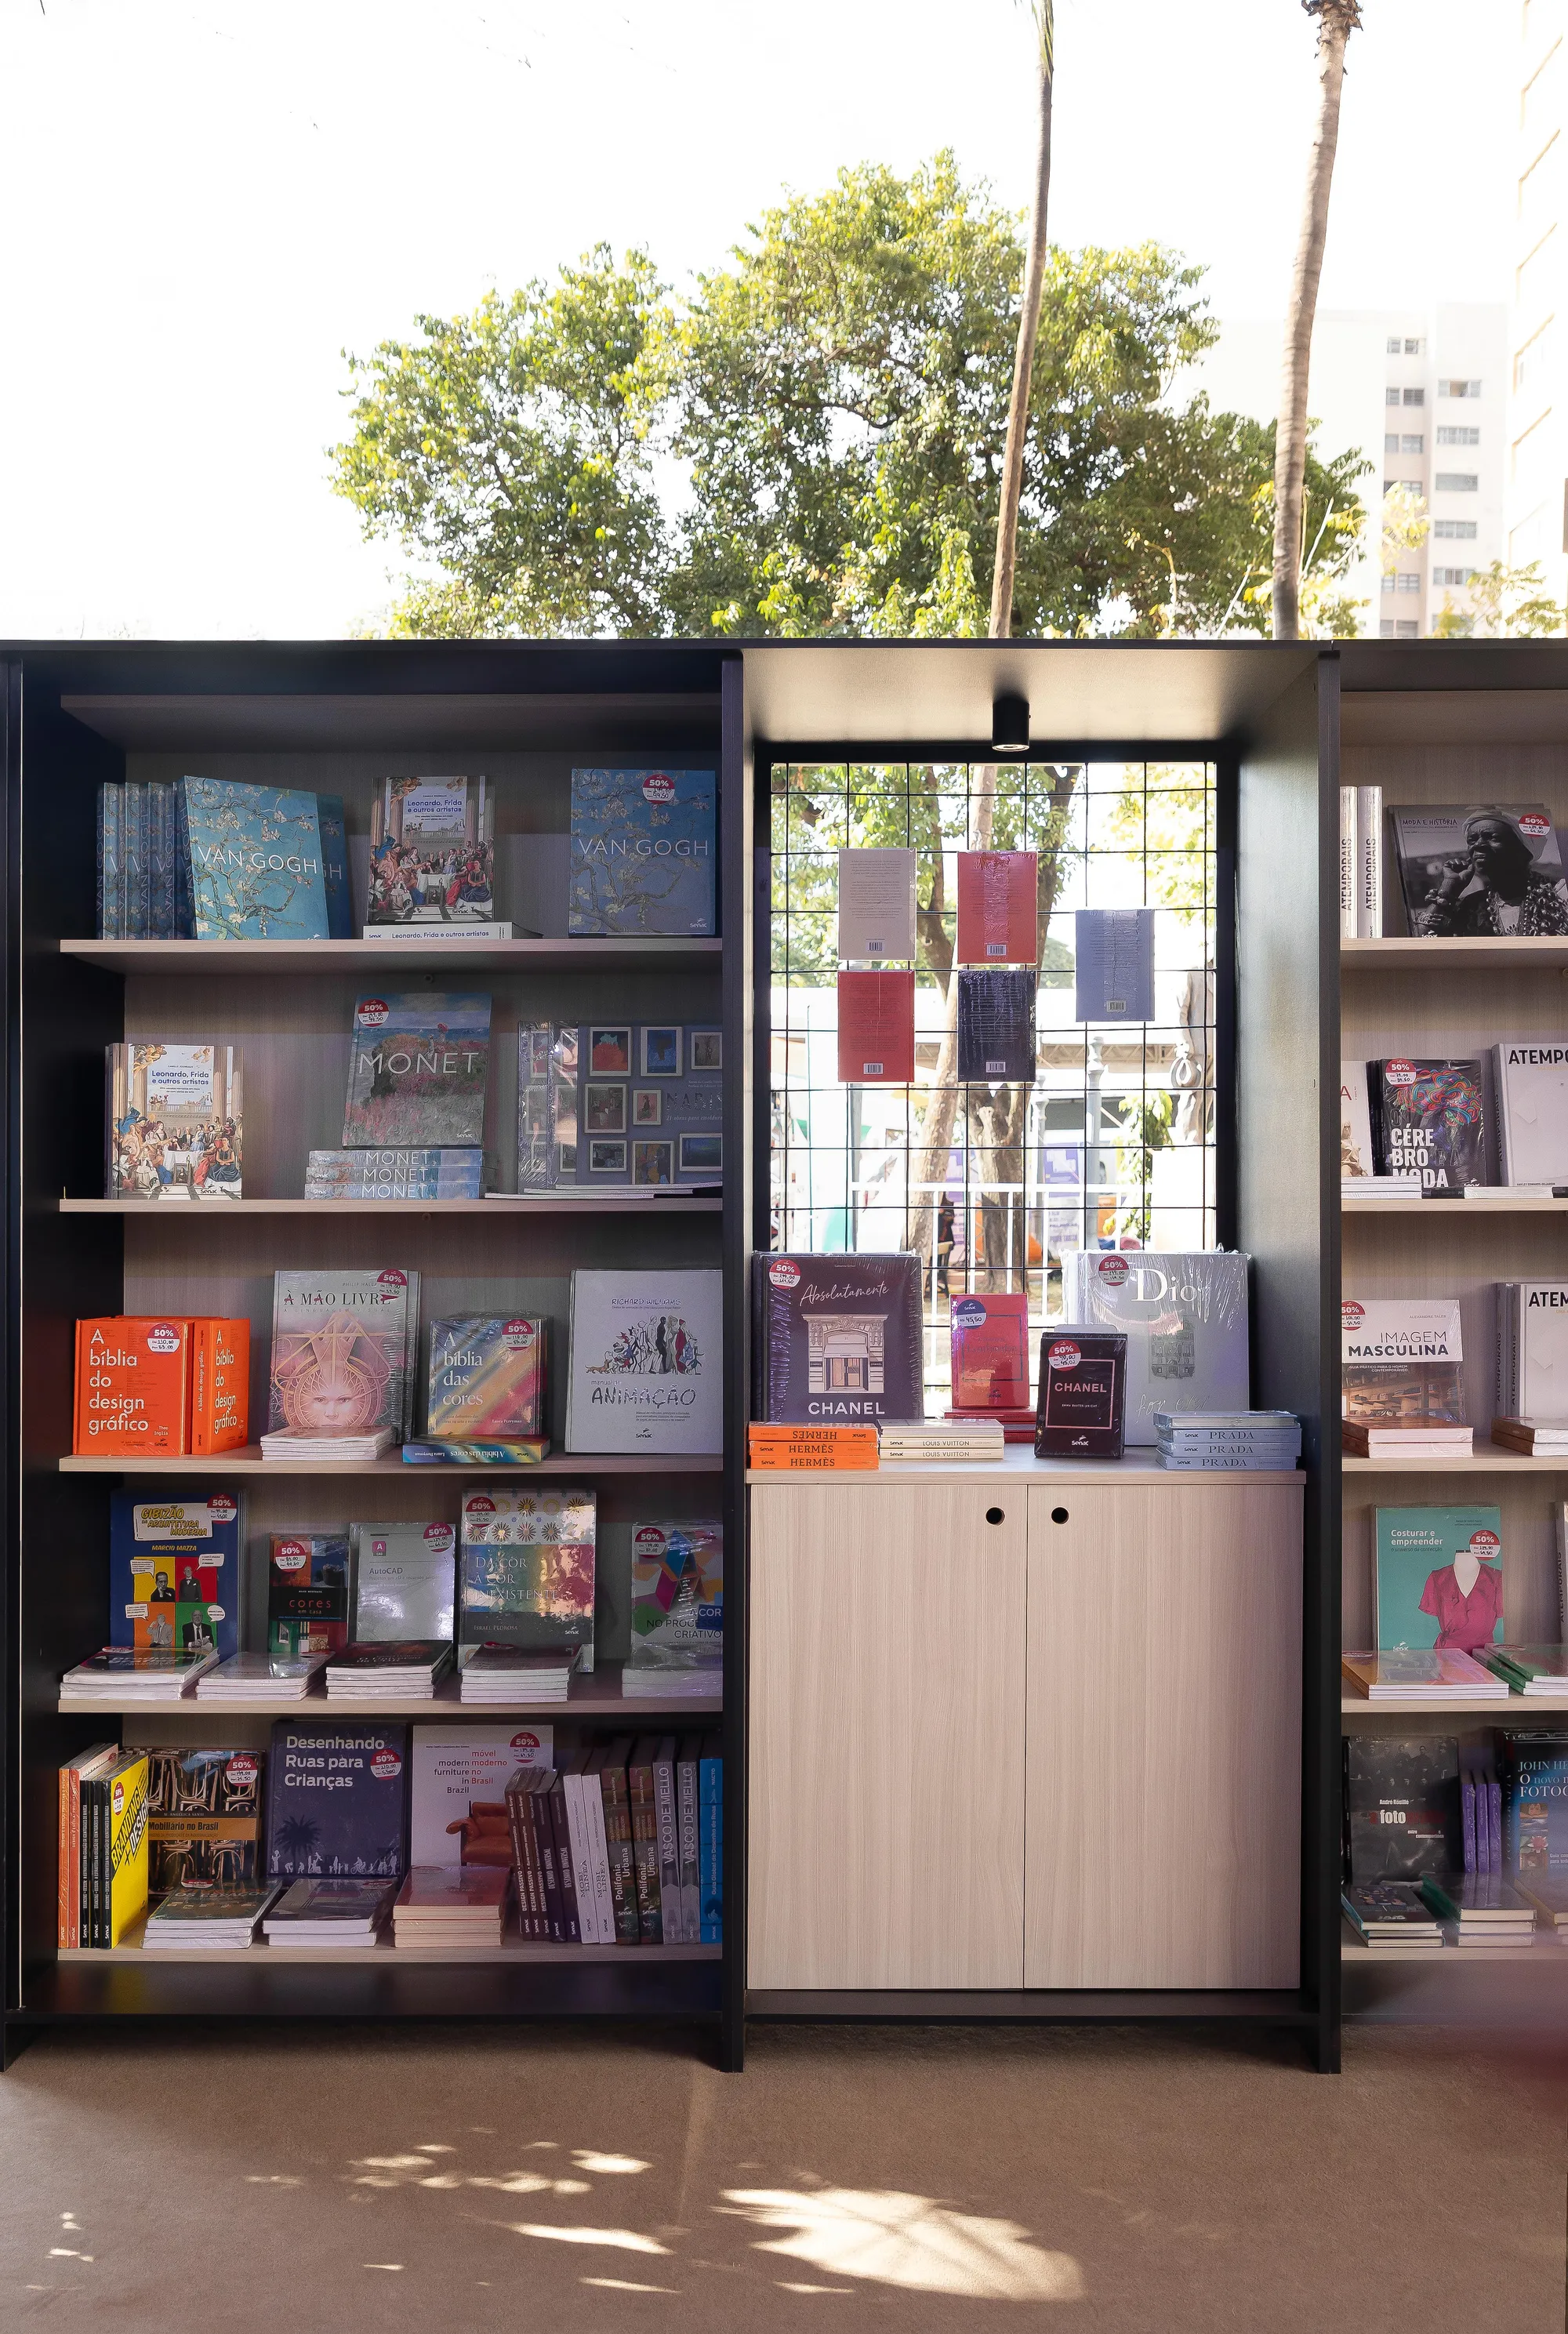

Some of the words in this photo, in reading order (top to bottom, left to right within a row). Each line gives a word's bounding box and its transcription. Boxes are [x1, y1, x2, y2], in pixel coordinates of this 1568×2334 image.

[579, 839, 626, 855] VAN
[636, 840, 708, 855] GOGH
[198, 847, 243, 867] VAN
[251, 852, 318, 874] GOGH
[358, 1052, 479, 1074] MONET
[1391, 1123, 1434, 1146] CÉRE
[365, 1152, 430, 1165] MONET
[1392, 1149, 1428, 1167] BRO
[363, 1168, 428, 1182] MONET
[361, 1185, 427, 1199] MONET
[284, 1290, 295, 1305] À
[300, 1290, 336, 1305] MÃO
[800, 1280, 890, 1306] Absolutamente
[90, 1328, 105, 1345] A
[216, 1330, 223, 1345] A
[444, 1332, 456, 1346] A
[1381, 1331, 1447, 1343] IMAGEM
[89, 1348, 138, 1367] bíblia
[216, 1348, 234, 1366] bíblia
[1348, 1344, 1449, 1356] MASCULINA
[444, 1350, 483, 1366] bíblia
[89, 1370, 112, 1387] do
[215, 1370, 225, 1387] do
[443, 1370, 470, 1386] das
[1054, 1382, 1107, 1392] CHANEL
[89, 1391, 144, 1414] design
[215, 1391, 236, 1410] design
[442, 1393, 484, 1406] cores
[591, 1384, 696, 1409] ANIMAÇÃO
[808, 1402, 885, 1415] CHANEL
[88, 1413, 149, 1436] gráfico
[214, 1410, 238, 1435] gráfico
[793, 1431, 837, 1440] HERMÈS
[789, 1443, 833, 1453] HERMÈS
[790, 1457, 835, 1466] HERMÈS
[141, 1505, 184, 1519] GIBIZÃO
[147, 1519, 200, 1528] ARQUITETURA
[1391, 1537, 1443, 1546] empreender
[499, 1557, 528, 1568] COR
[474, 1572, 482, 1584] À
[474, 1589, 559, 1599] INEXISTENTE
[289, 1599, 332, 1608] cores
[287, 1736, 385, 1749] Desenhando
[285, 1755, 325, 1767] Ruas
[328, 1756, 364, 1770] para
[1518, 1761, 1550, 1772] JOHN
[285, 1773, 354, 1790] Crianças
[659, 1767, 670, 1805] MELLO
[683, 1767, 693, 1805] MELLO
[1519, 1773, 1530, 1784] O
[662, 1808, 671, 1823] DE
[684, 1808, 693, 1823] DE
[111, 1789, 141, 1868] BRANDING
[129, 1793, 148, 1853] DESIGN
[662, 1827, 673, 1864] VASCO
[684, 1827, 695, 1864] VASCO
[614, 1864, 623, 1900] Polifonia
[639, 1862, 648, 1899] Polifonia
